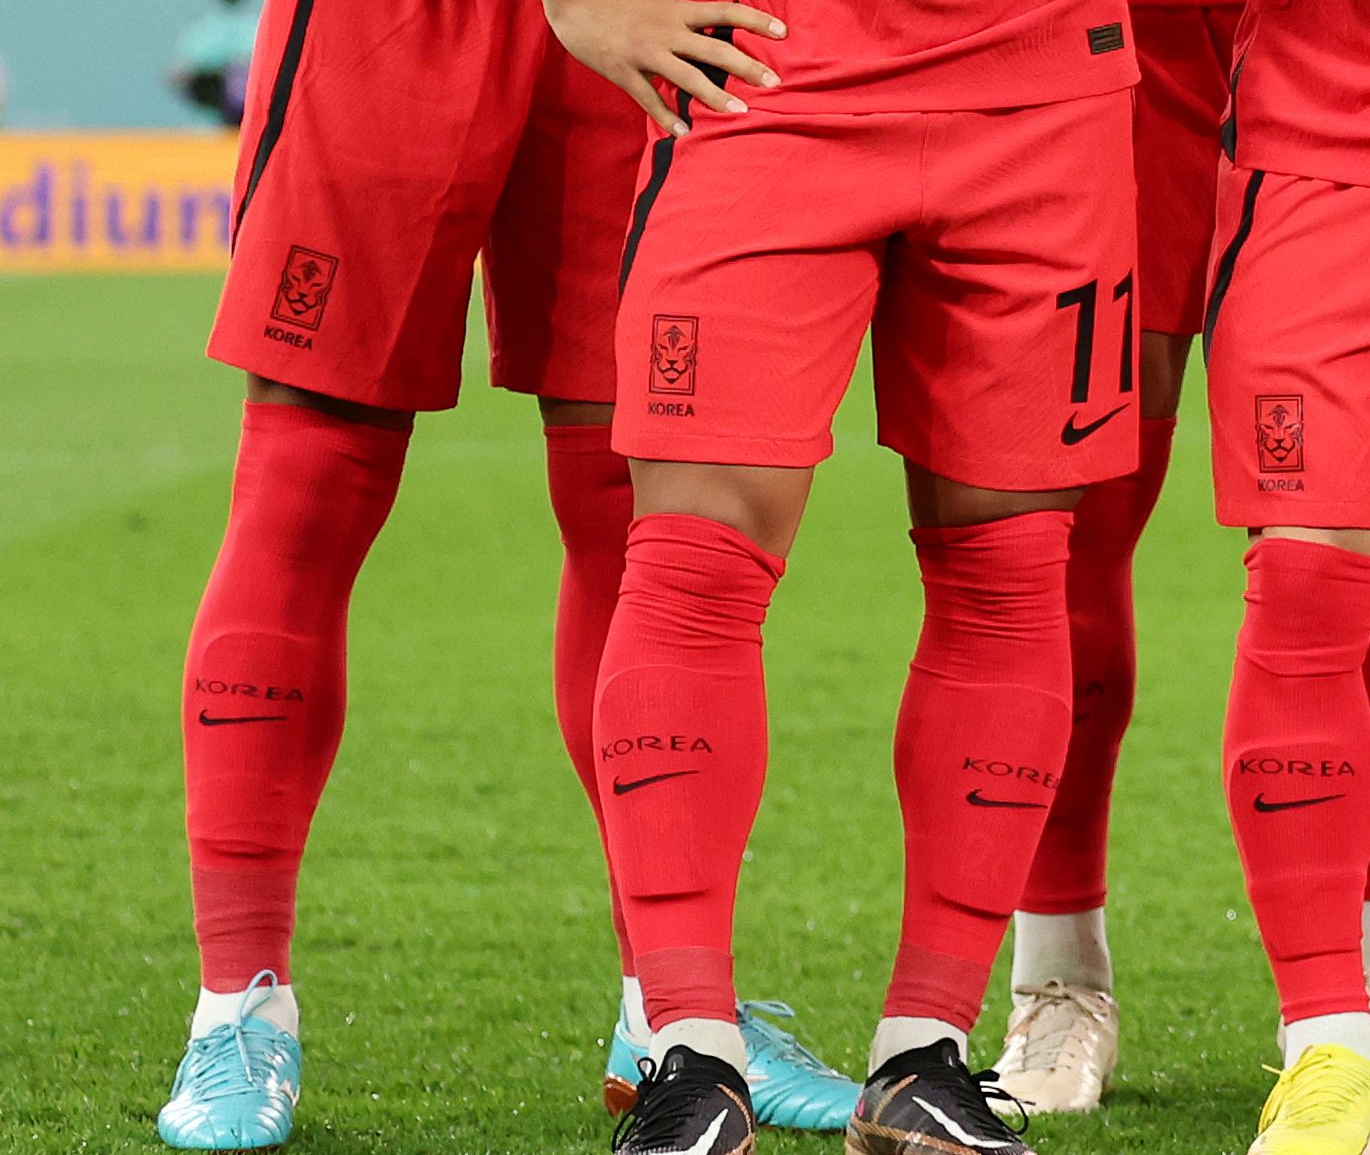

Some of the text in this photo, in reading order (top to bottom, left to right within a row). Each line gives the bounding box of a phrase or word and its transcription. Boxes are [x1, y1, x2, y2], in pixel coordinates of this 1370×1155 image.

[263, 324, 314, 351] KOREA
[1056, 268, 1133, 404] 11
[647, 401, 695, 418] KOREA
[1257, 478, 1305, 492] KOREA
[195, 678, 305, 703] KOREA
[602, 735, 713, 762] KOREA
[1238, 758, 1357, 779] KOREA
